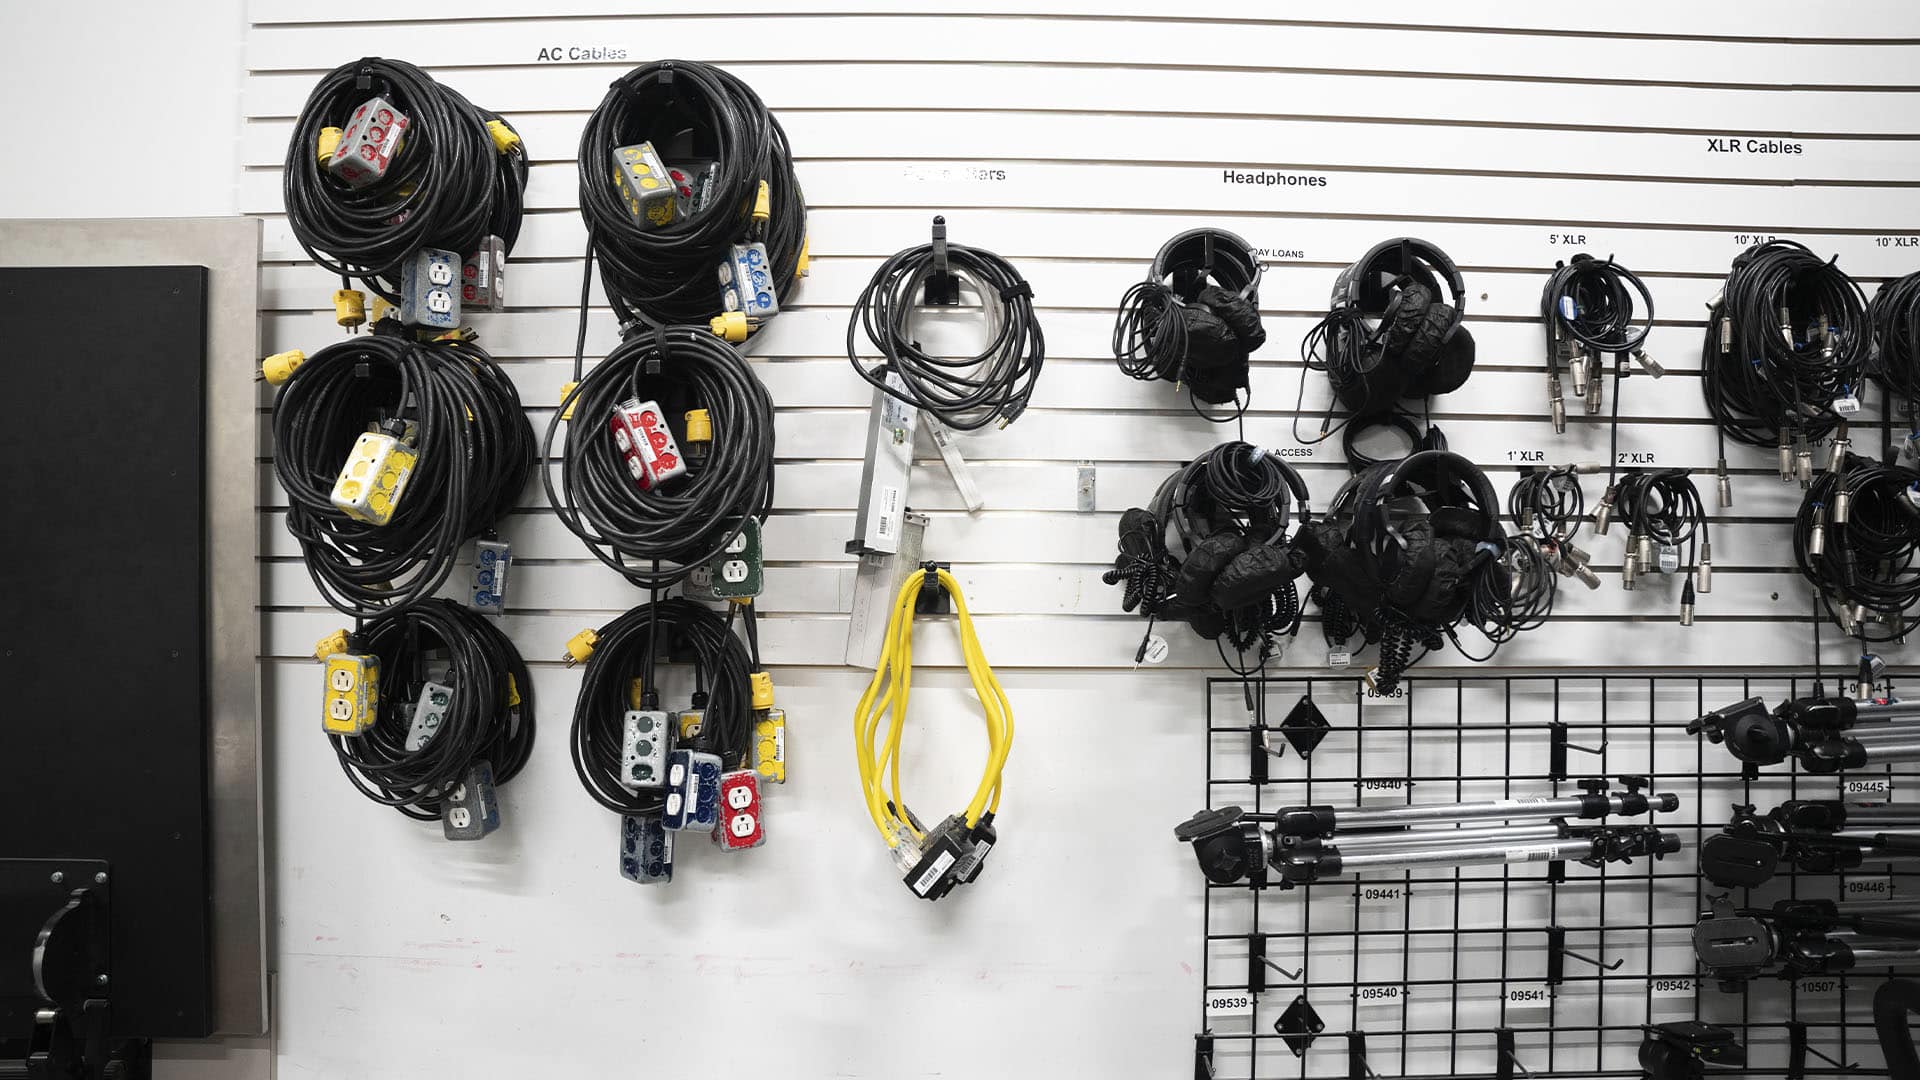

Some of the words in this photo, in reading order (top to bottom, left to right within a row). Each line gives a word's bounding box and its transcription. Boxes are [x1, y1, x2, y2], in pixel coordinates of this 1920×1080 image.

[537, 47, 563, 61] AC
[568, 46, 628, 61] Cables
[1707, 139, 1741, 153] XLR
[1746, 139, 1803, 154] Cables
[1223, 170, 1327, 187] Headphones
[1549, 234, 1559, 244] 5'
[1563, 234, 1586, 245] XLR
[1734, 234, 1750, 245] 10'
[1875, 237, 1892, 247] 10'
[1895, 237, 1919, 247] XLR
[1272, 249, 1304, 258] LOANS
[1274, 448, 1313, 457] ACCESS
[1507, 450, 1517, 461] 1'
[1520, 451, 1544, 461] XLR
[1618, 453, 1628, 463] 2'
[1632, 453, 1655, 464] XLR
[1366, 780, 1401, 790] 09440
[1849, 782, 1884, 792] 09445
[1849, 882, 1885, 893] 09446
[1365, 889, 1400, 900] 09441
[1656, 980, 1690, 991] 09542
[1802, 981, 1835, 992] 10507
[1362, 987, 1397, 999] 09540
[1510, 990, 1545, 1001] 09541
[1212, 997, 1247, 1009] 09539
